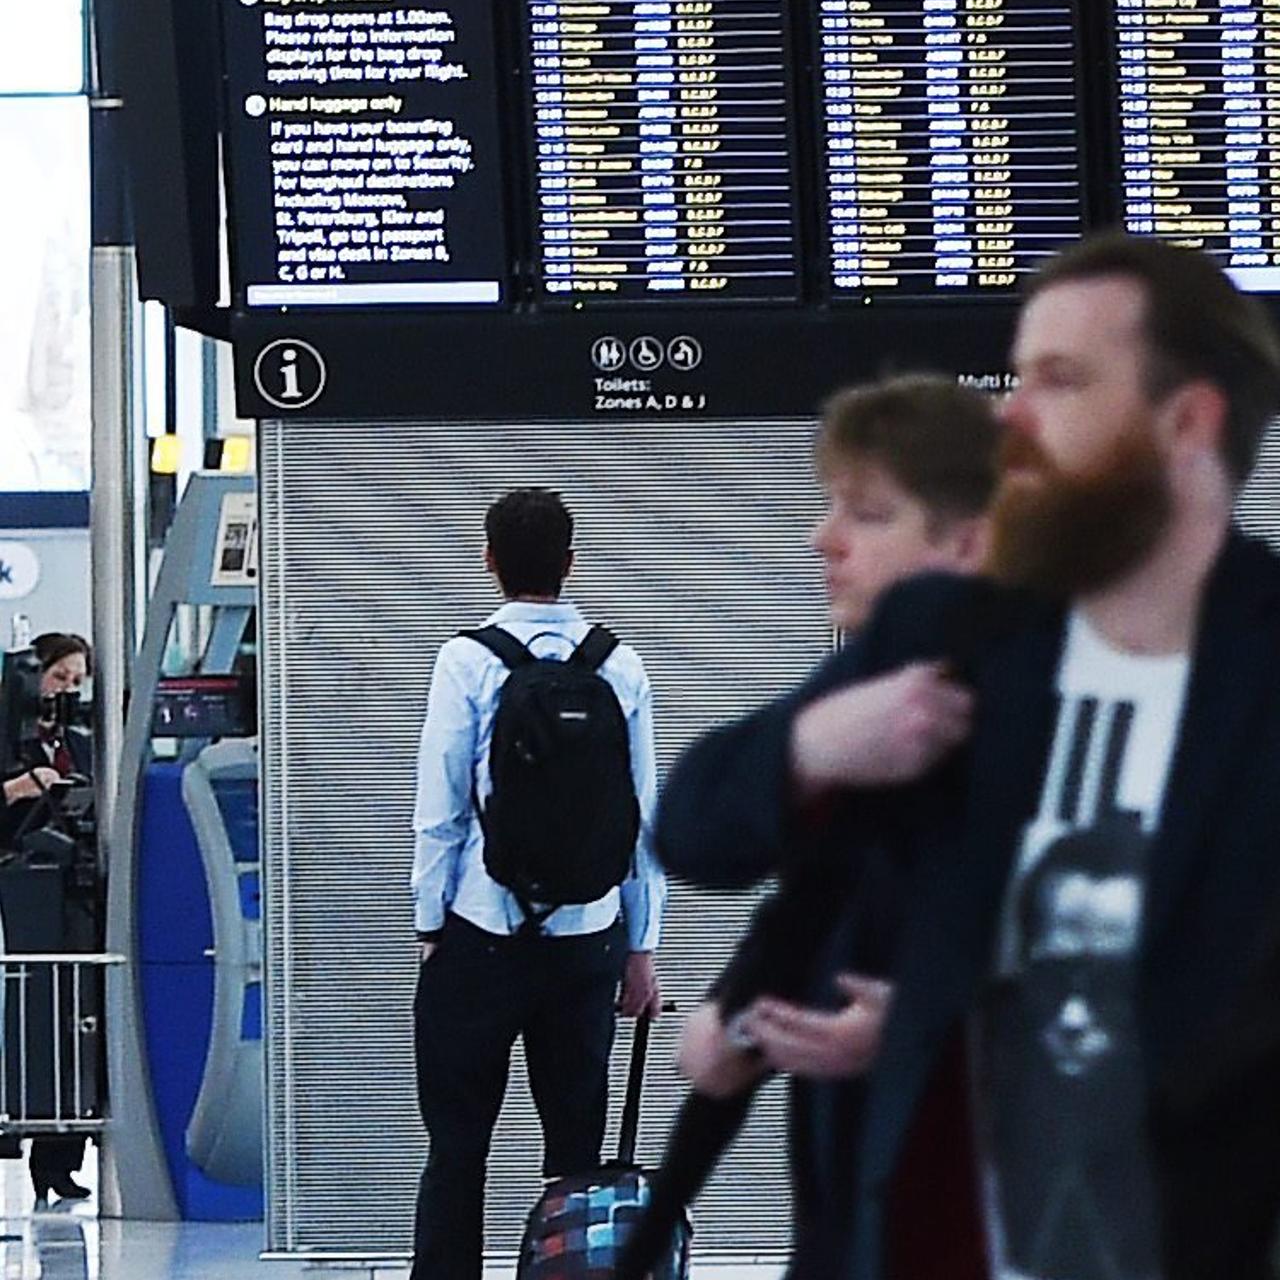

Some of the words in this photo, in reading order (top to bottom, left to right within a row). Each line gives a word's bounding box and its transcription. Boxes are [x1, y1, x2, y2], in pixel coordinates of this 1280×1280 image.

[295, 12, 330, 28] drop
[266, 31, 310, 44] Please
[313, 29, 348, 44] refer
[351, 30, 367, 43] to
[369, 28, 454, 43] information
[326, 48, 347, 62] for
[350, 48, 374, 62] the
[406, 46, 442, 62] drop
[330, 65, 362, 80] time
[365, 65, 386, 79] for
[389, 67, 422, 82] your
[270, 97, 308, 111] Hand
[370, 96, 402, 113] only
[284, 124, 311, 138] you
[350, 123, 384, 138] your
[271, 140, 303, 154] card
[305, 138, 333, 153] and
[336, 138, 374, 152] hand
[273, 160, 301, 174] you
[302, 159, 328, 171] can
[372, 159, 392, 170] on
[394, 157, 410, 170] to
[415, 209, 444, 224] and
[329, 231, 350, 245] go
[351, 230, 368, 243] to
[278, 247, 306, 262] and
[310, 268, 326, 280] or
[594, 377, 651, 392] Toilets:
[595, 395, 642, 410] Zones
[665, 394, 678, 408] D
[682, 395, 695, 408] &
